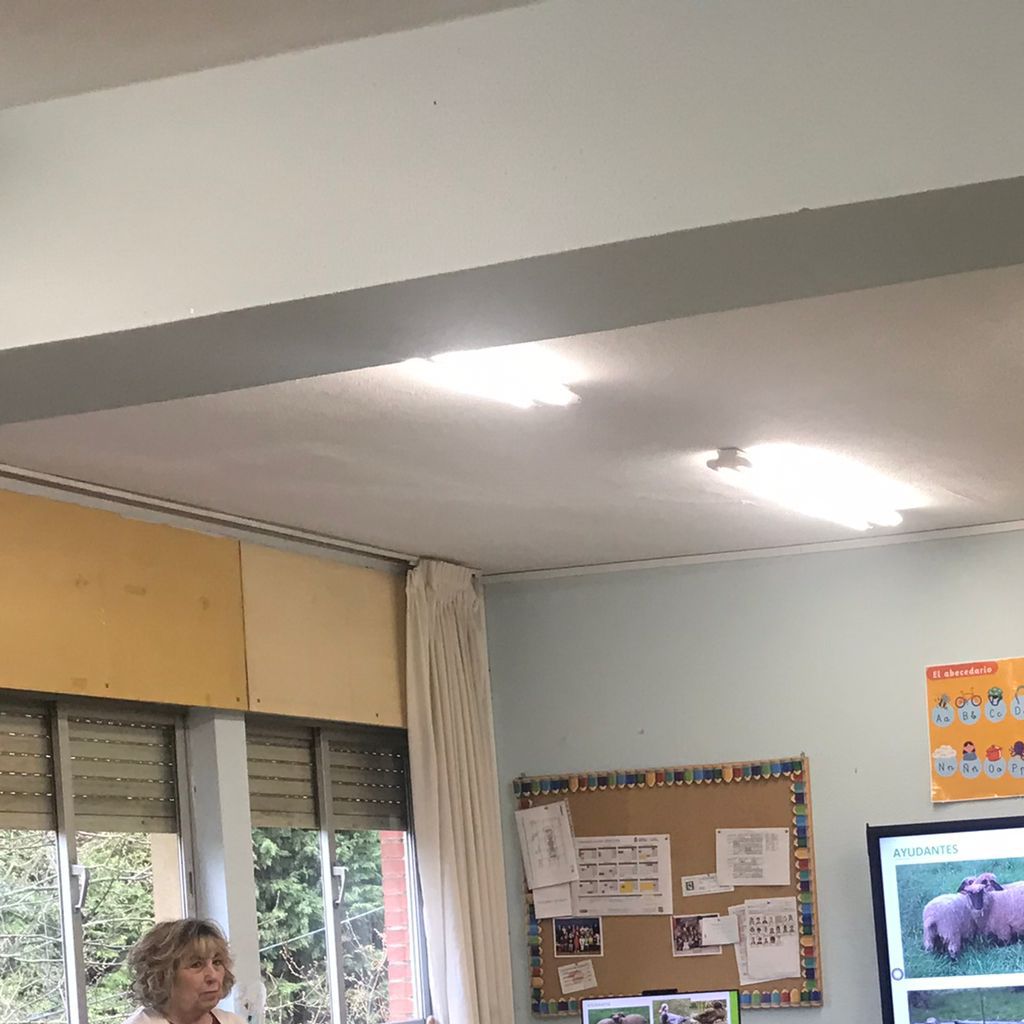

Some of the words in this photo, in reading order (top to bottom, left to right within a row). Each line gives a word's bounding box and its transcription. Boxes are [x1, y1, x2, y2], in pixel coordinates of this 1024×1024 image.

[932, 671, 941, 679] El
[944, 666, 993, 678] abecedario
[893, 844, 959, 858] AYUDANTES
